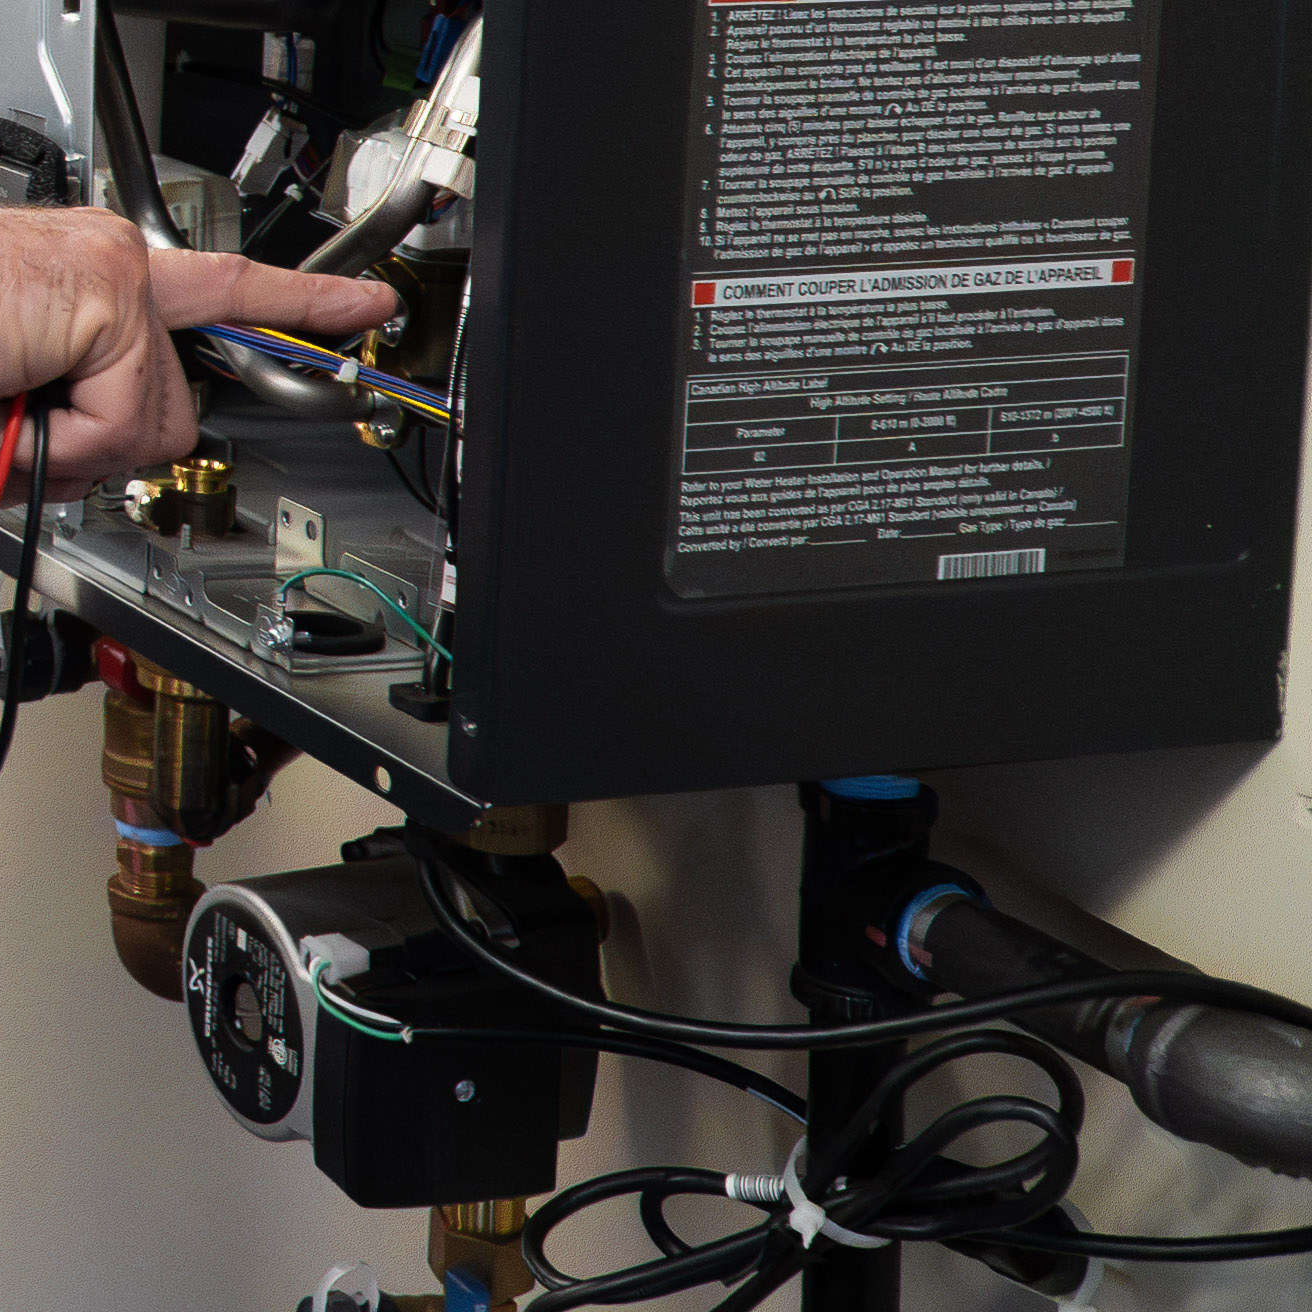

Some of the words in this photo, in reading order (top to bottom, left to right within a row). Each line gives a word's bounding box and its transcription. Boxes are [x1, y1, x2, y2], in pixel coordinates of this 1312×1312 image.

[722, 282, 792, 300] COMMENT
[798, 279, 855, 296] COUPER
[860, 274, 947, 292] L'ADMISSION
[951, 273, 969, 288] DE
[973, 271, 1001, 286] GAZ
[1004, 270, 1022, 285] DE
[1026, 266, 1104, 284] L'APPAREIL
